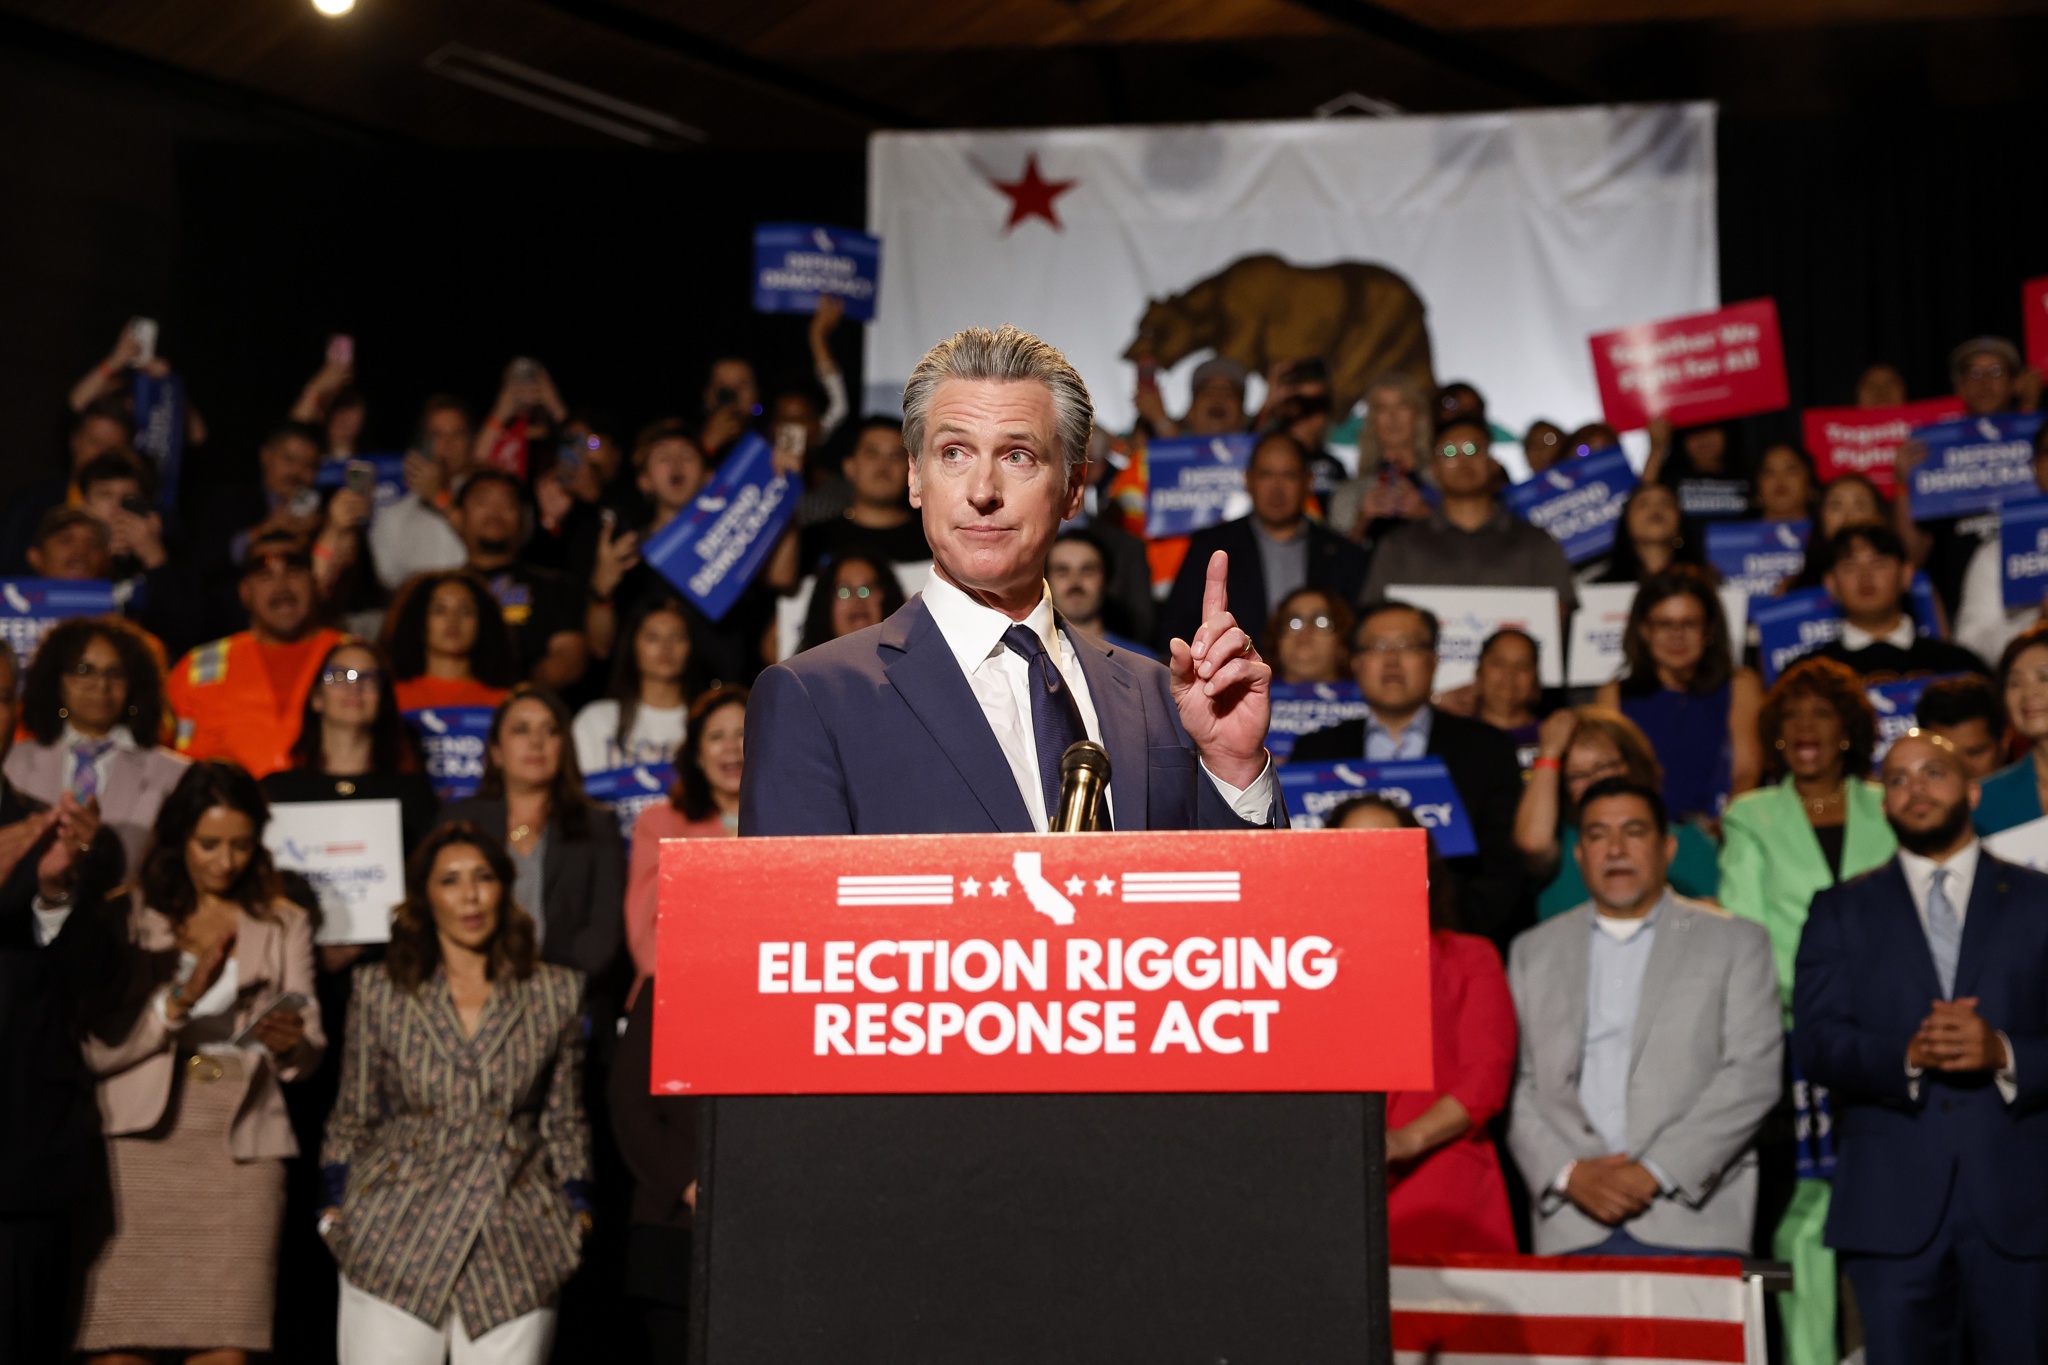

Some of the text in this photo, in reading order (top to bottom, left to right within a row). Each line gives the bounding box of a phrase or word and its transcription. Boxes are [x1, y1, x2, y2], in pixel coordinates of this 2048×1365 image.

[785, 252, 857, 275] DEFEND
[1944, 440, 2033, 467] DEFEND
[1916, 466, 2034, 494] DEMOCRA
[695, 483, 761, 562] DEFEND
[758, 936, 1338, 993] ELECTION RIGGING
[813, 999, 1280, 1056] RESPONSE ACT
